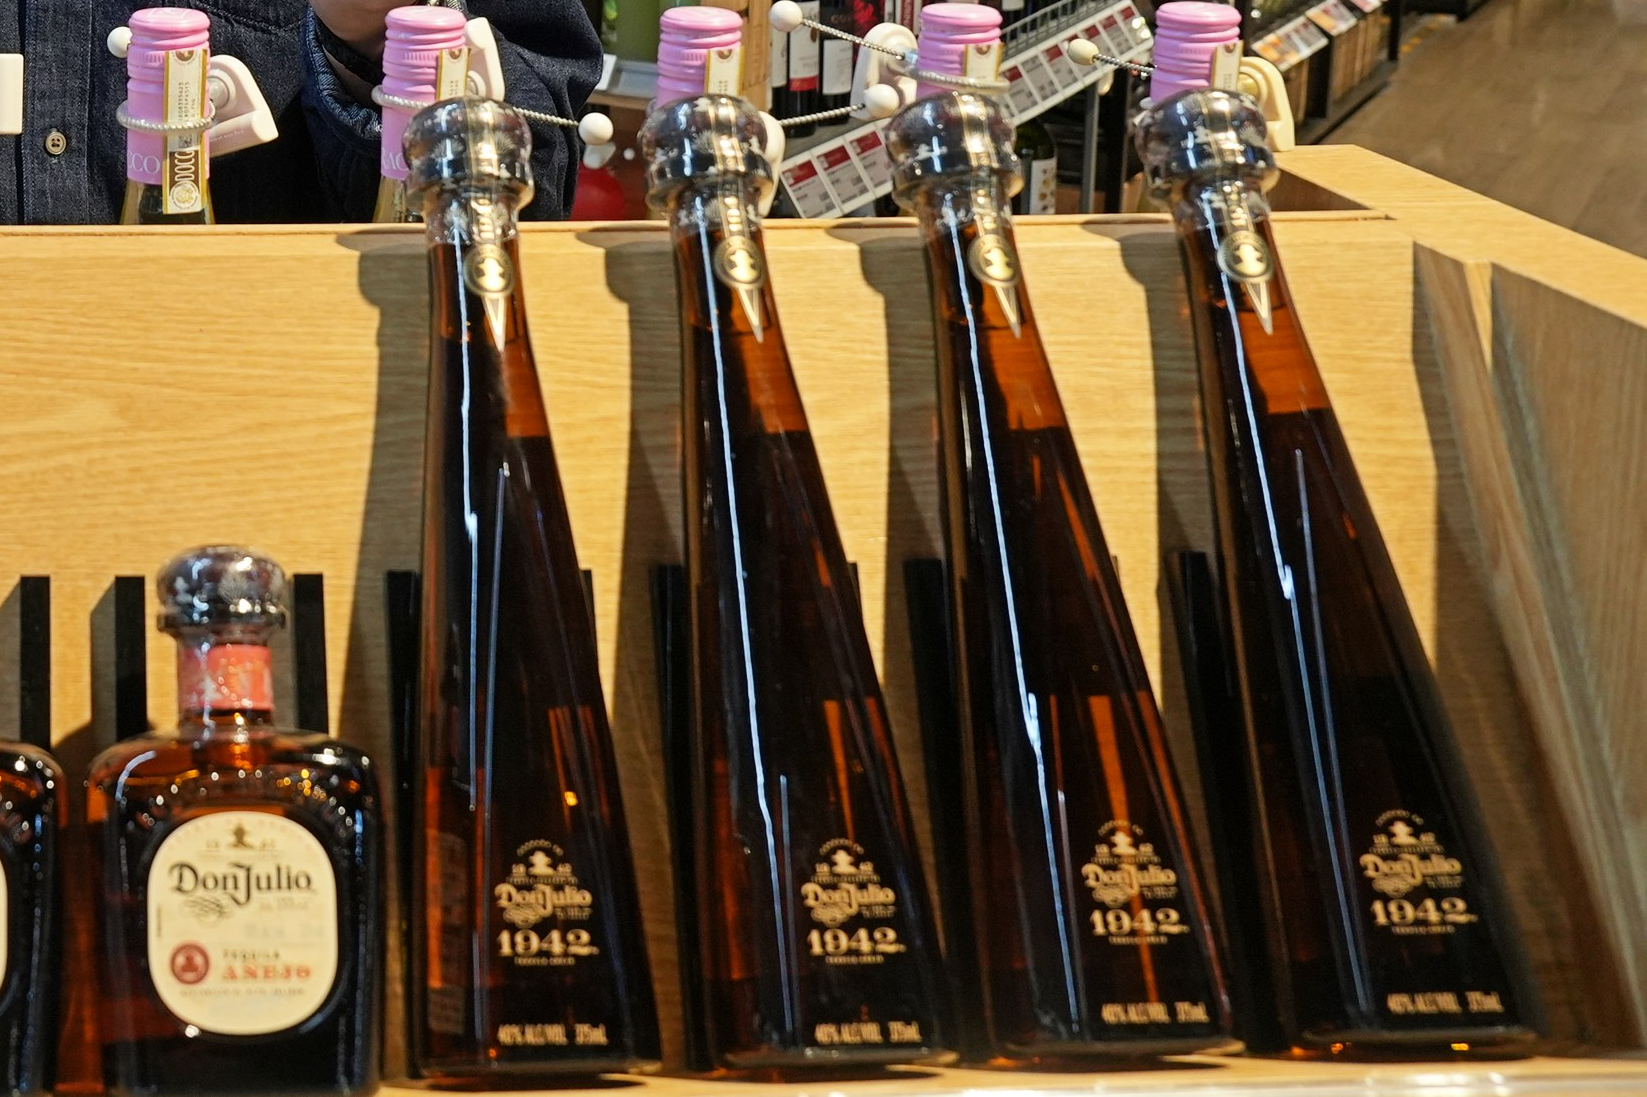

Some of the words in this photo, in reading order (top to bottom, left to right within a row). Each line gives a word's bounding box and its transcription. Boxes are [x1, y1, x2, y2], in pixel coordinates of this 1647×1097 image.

[1090, 907, 1191, 936] 1942
[1370, 897, 1479, 927] 1942
[497, 929, 600, 957] 1942
[807, 927, 907, 956] 1942
